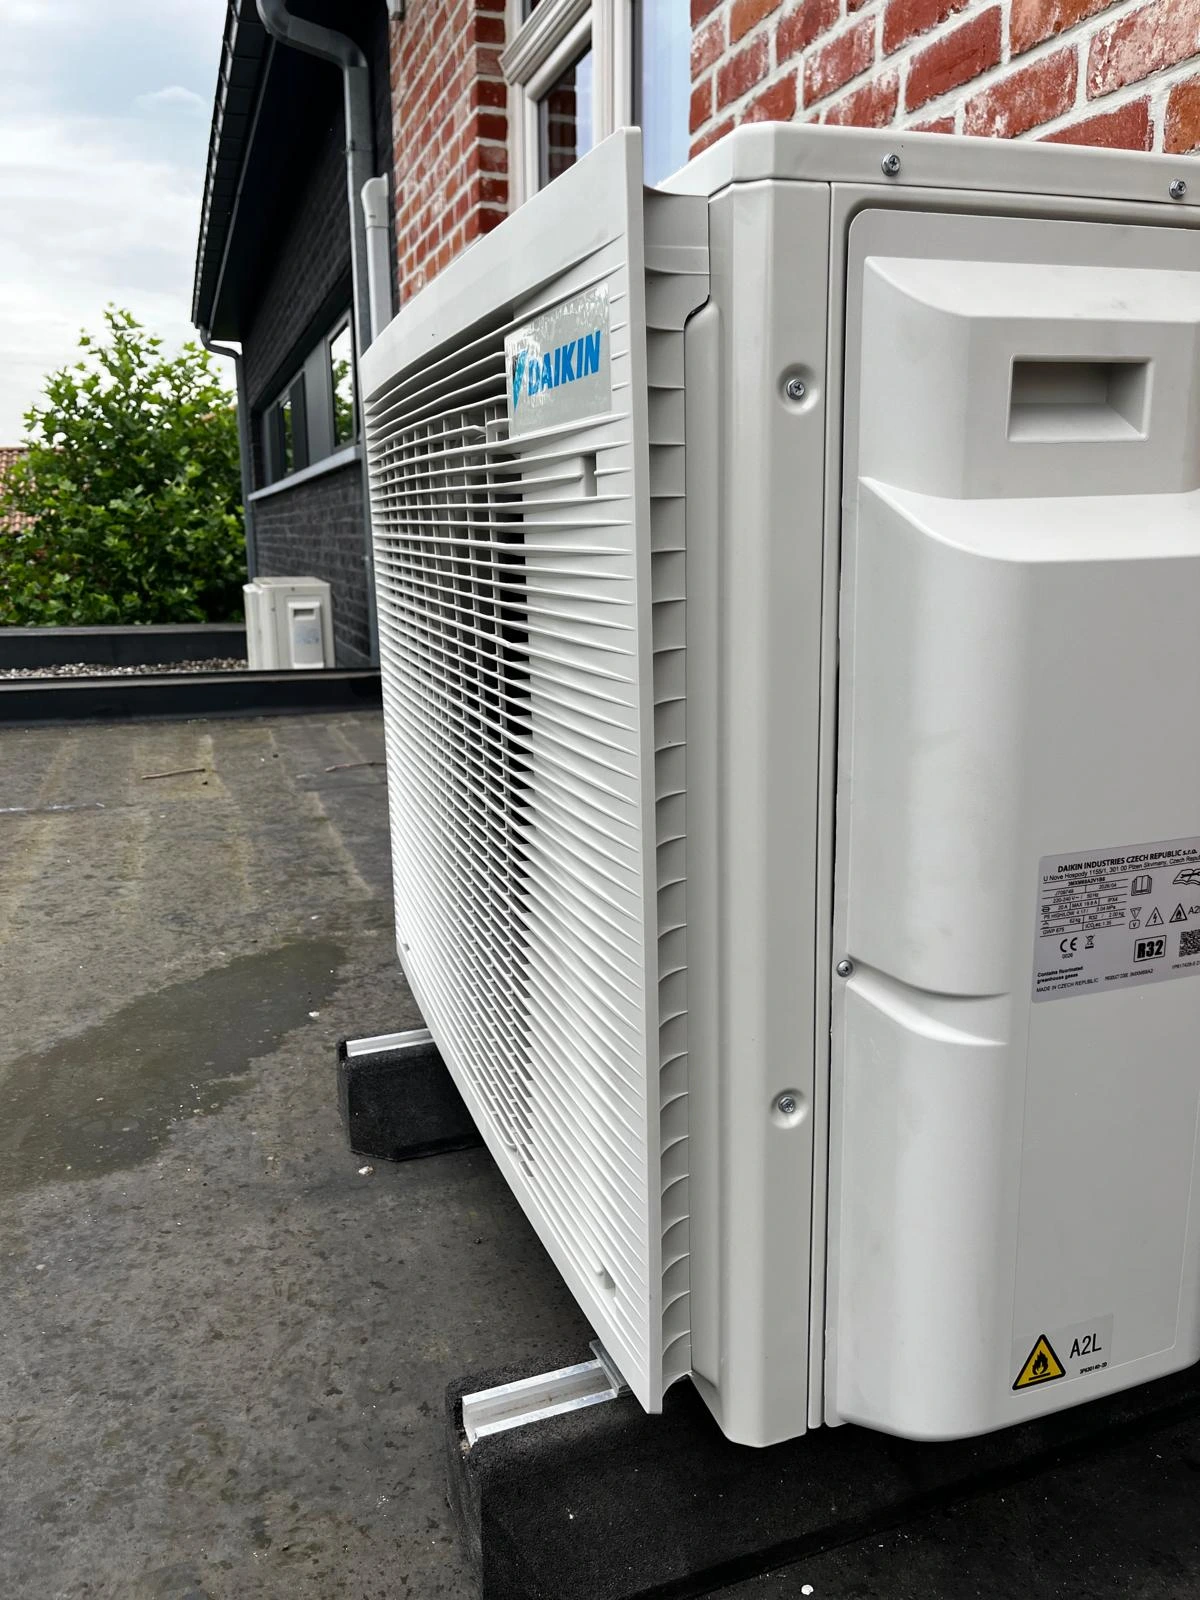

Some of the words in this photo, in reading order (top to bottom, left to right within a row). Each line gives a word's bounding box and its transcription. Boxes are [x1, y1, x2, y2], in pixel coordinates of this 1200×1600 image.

[528, 330, 601, 396] DAIKIN
[1058, 864, 1083, 872] DAIKIN
[1084, 858, 1125, 870] INDUSTRIES
[1126, 854, 1149, 864] CZECH
[1150, 850, 1182, 860] REPUBLIC
[1136, 940, 1164, 959] R32
[1069, 1332, 1102, 1358] A2L
